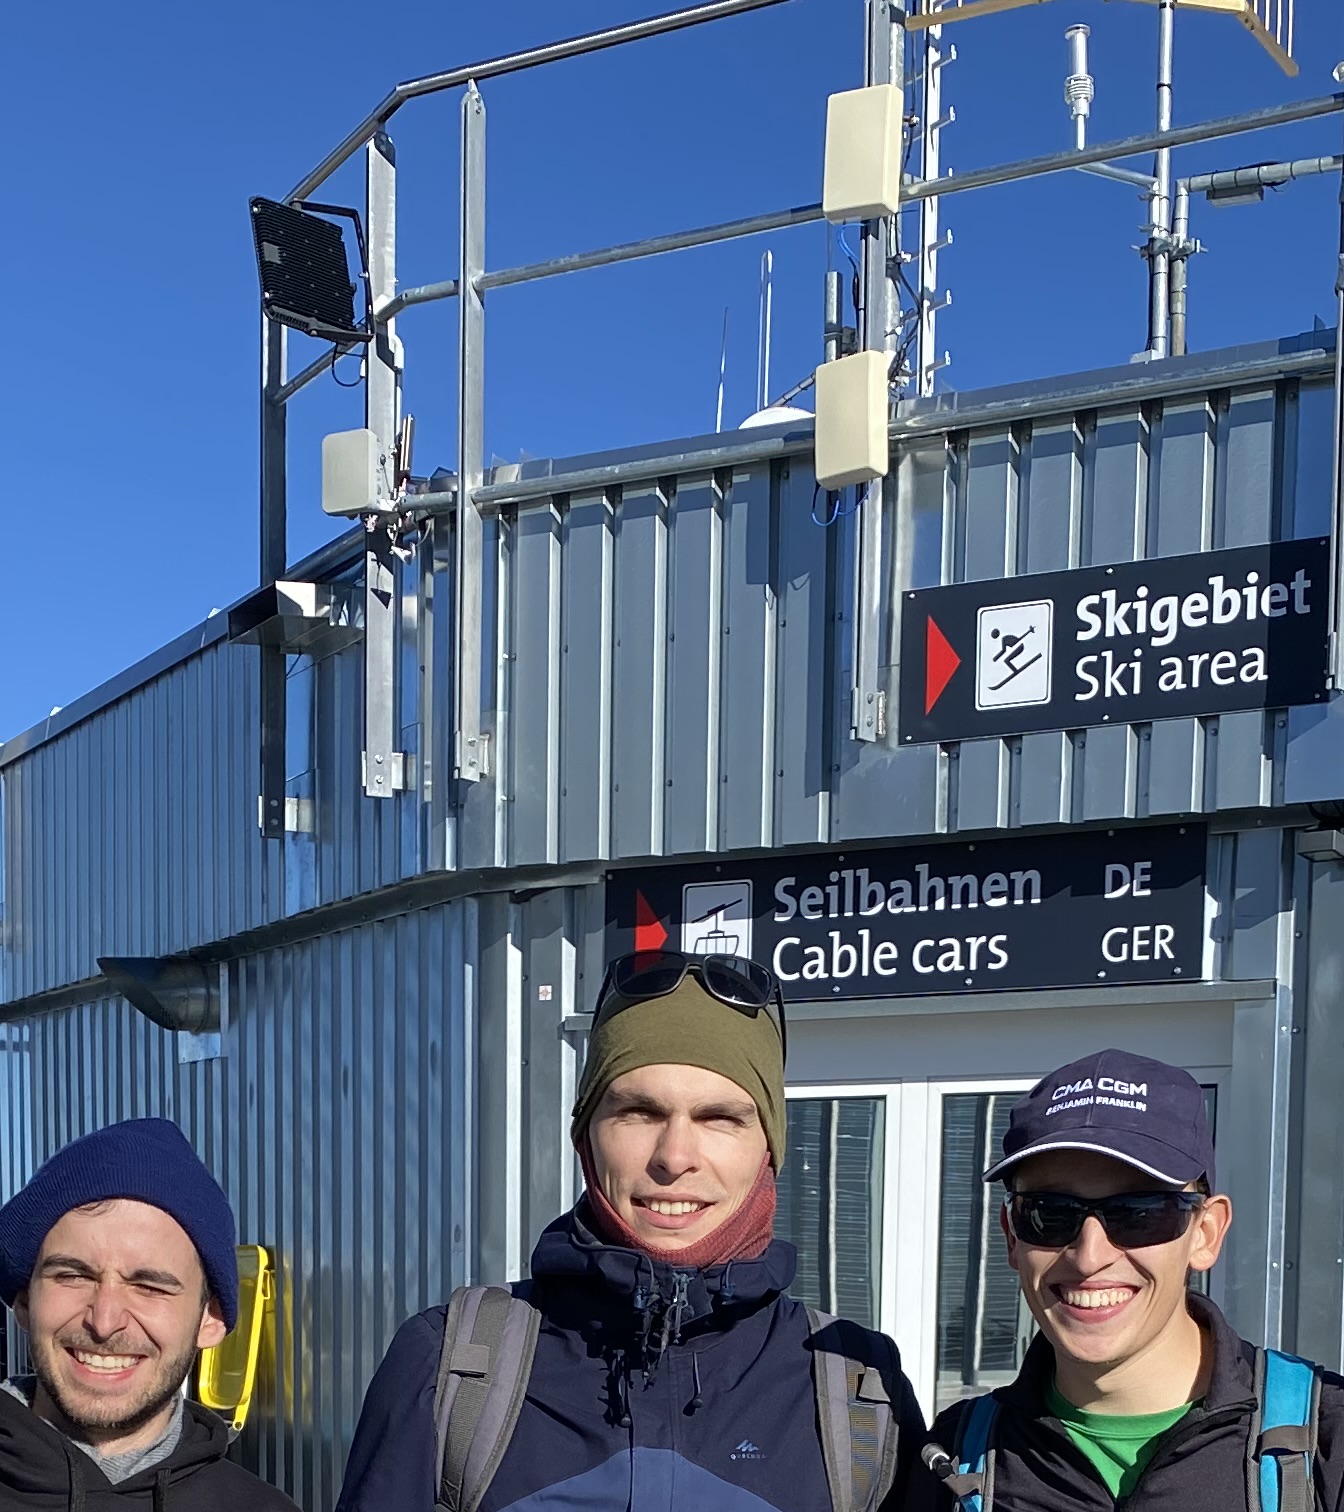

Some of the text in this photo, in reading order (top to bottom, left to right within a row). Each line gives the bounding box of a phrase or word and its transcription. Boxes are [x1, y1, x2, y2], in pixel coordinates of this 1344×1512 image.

[1074, 567, 1312, 647] Skigebiet
[1074, 645, 1268, 702] Ski area
[772, 861, 1153, 923] Seilbahnen DE
[772, 924, 1176, 982] Cable cars GER
[1045, 1095, 1147, 1116] BENJAMIN FRANKLIN
[1051, 1077, 1147, 1101] CMA CGM
